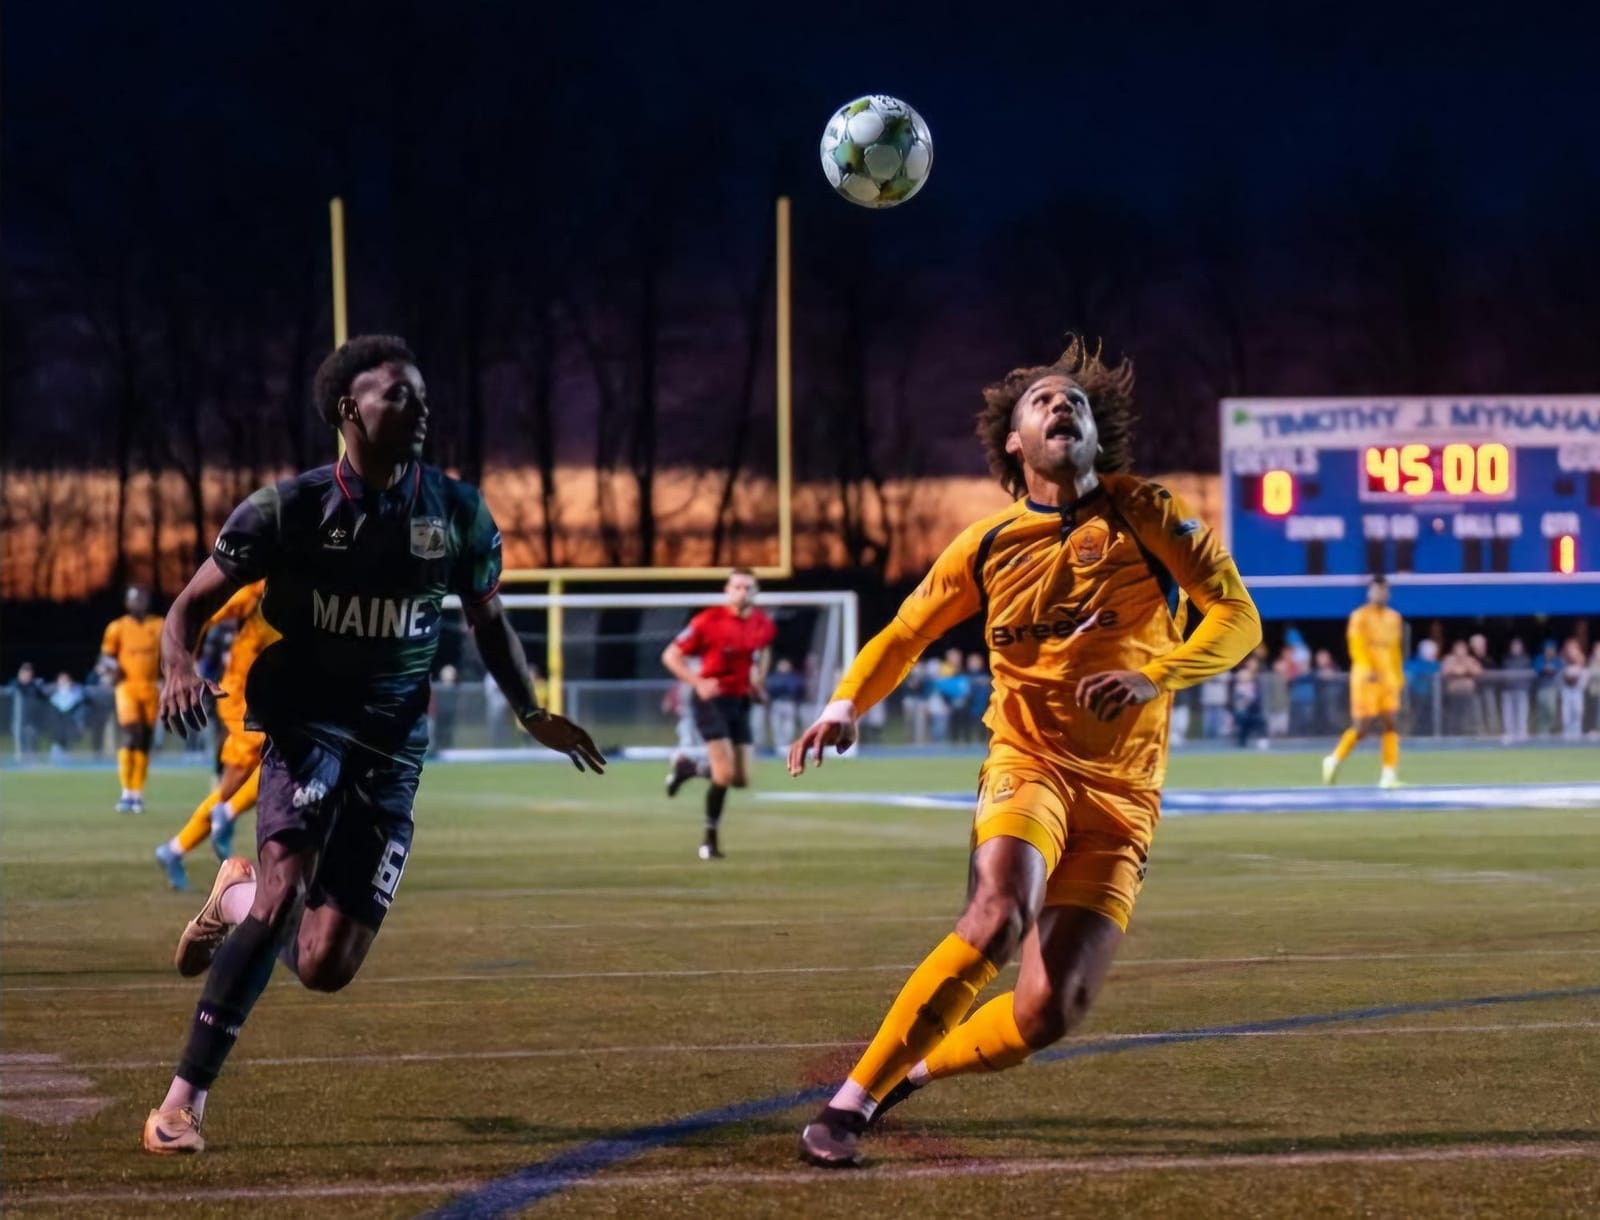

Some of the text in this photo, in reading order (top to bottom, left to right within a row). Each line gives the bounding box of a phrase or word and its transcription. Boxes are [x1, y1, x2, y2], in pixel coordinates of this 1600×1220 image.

[1259, 405, 1398, 438] TIMOTHY
[1450, 403, 1600, 433] MYNAHA
[1262, 470, 1293, 515] 0
[1559, 535, 1575, 574] 1
